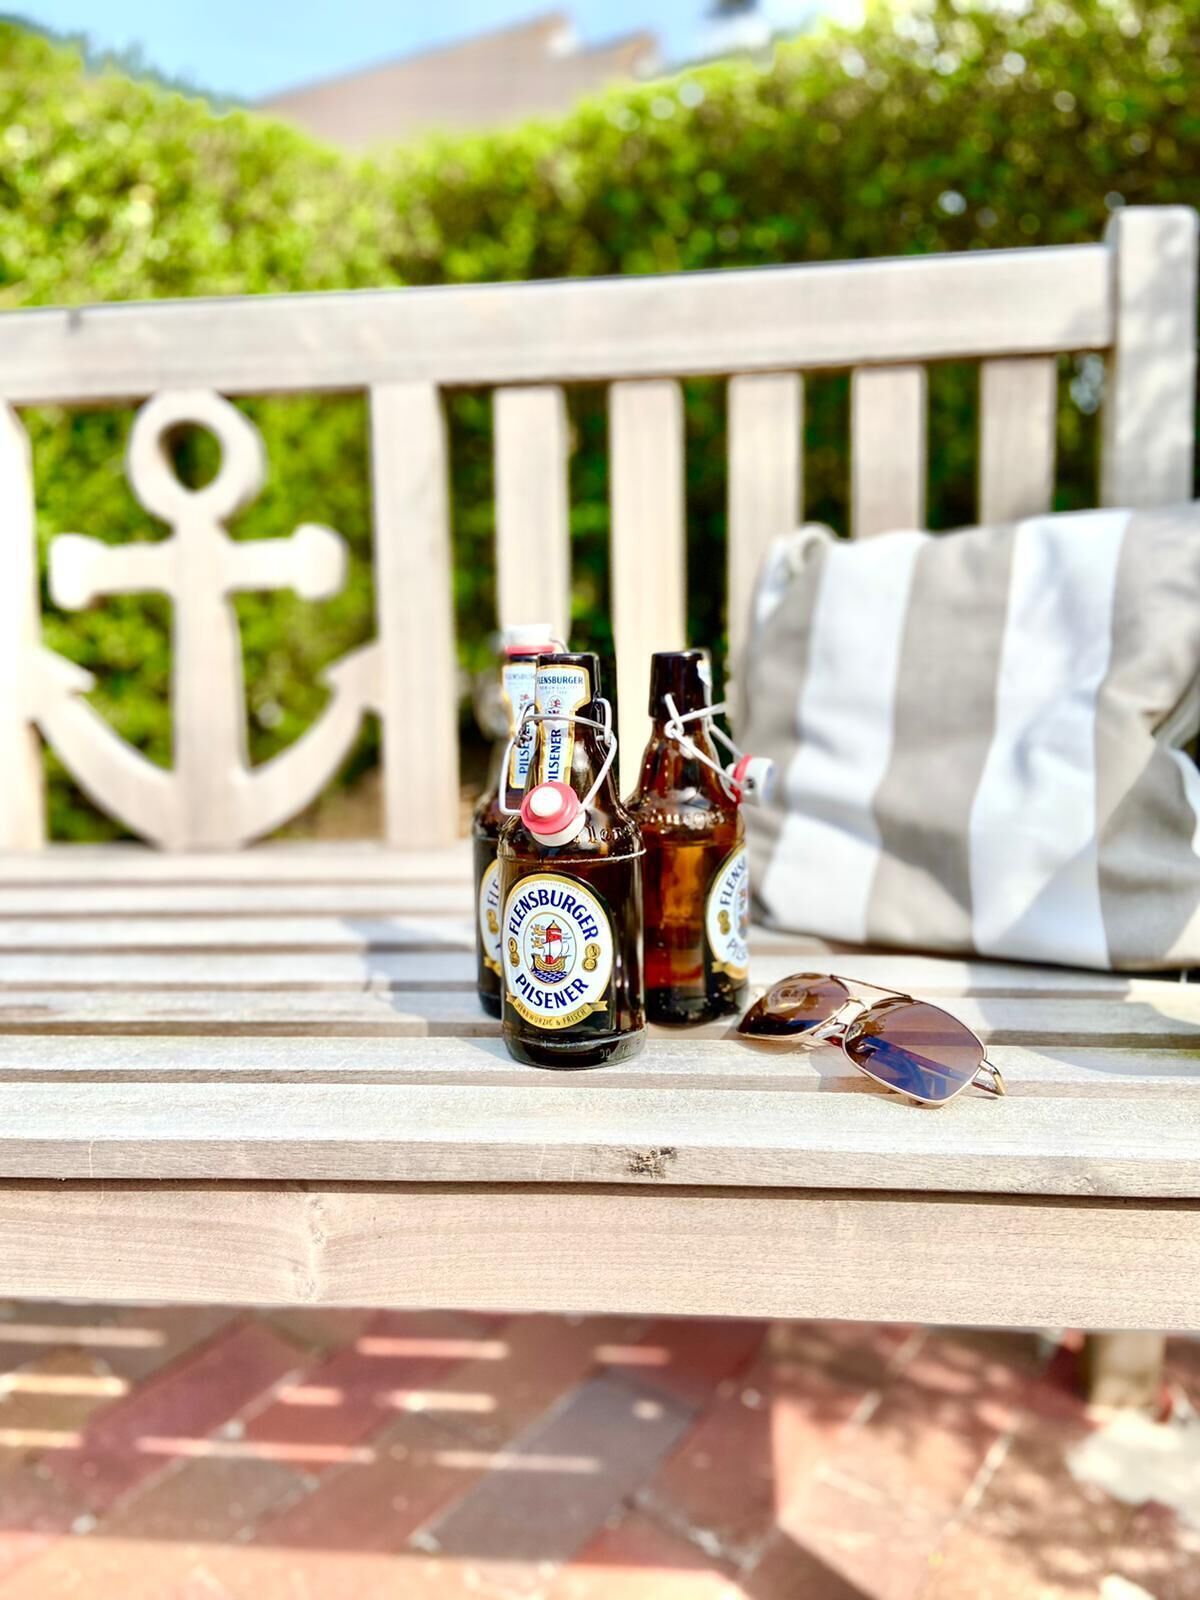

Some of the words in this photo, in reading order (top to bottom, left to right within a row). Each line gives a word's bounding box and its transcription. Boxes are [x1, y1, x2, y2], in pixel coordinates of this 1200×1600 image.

[538, 676, 584, 685] LENSBURGER
[548, 729, 562, 782] ILSENER
[508, 889, 599, 941] FLENSBURGER
[515, 973, 590, 1010] PILSENER
[563, 1008, 587, 1025] FRISCH
